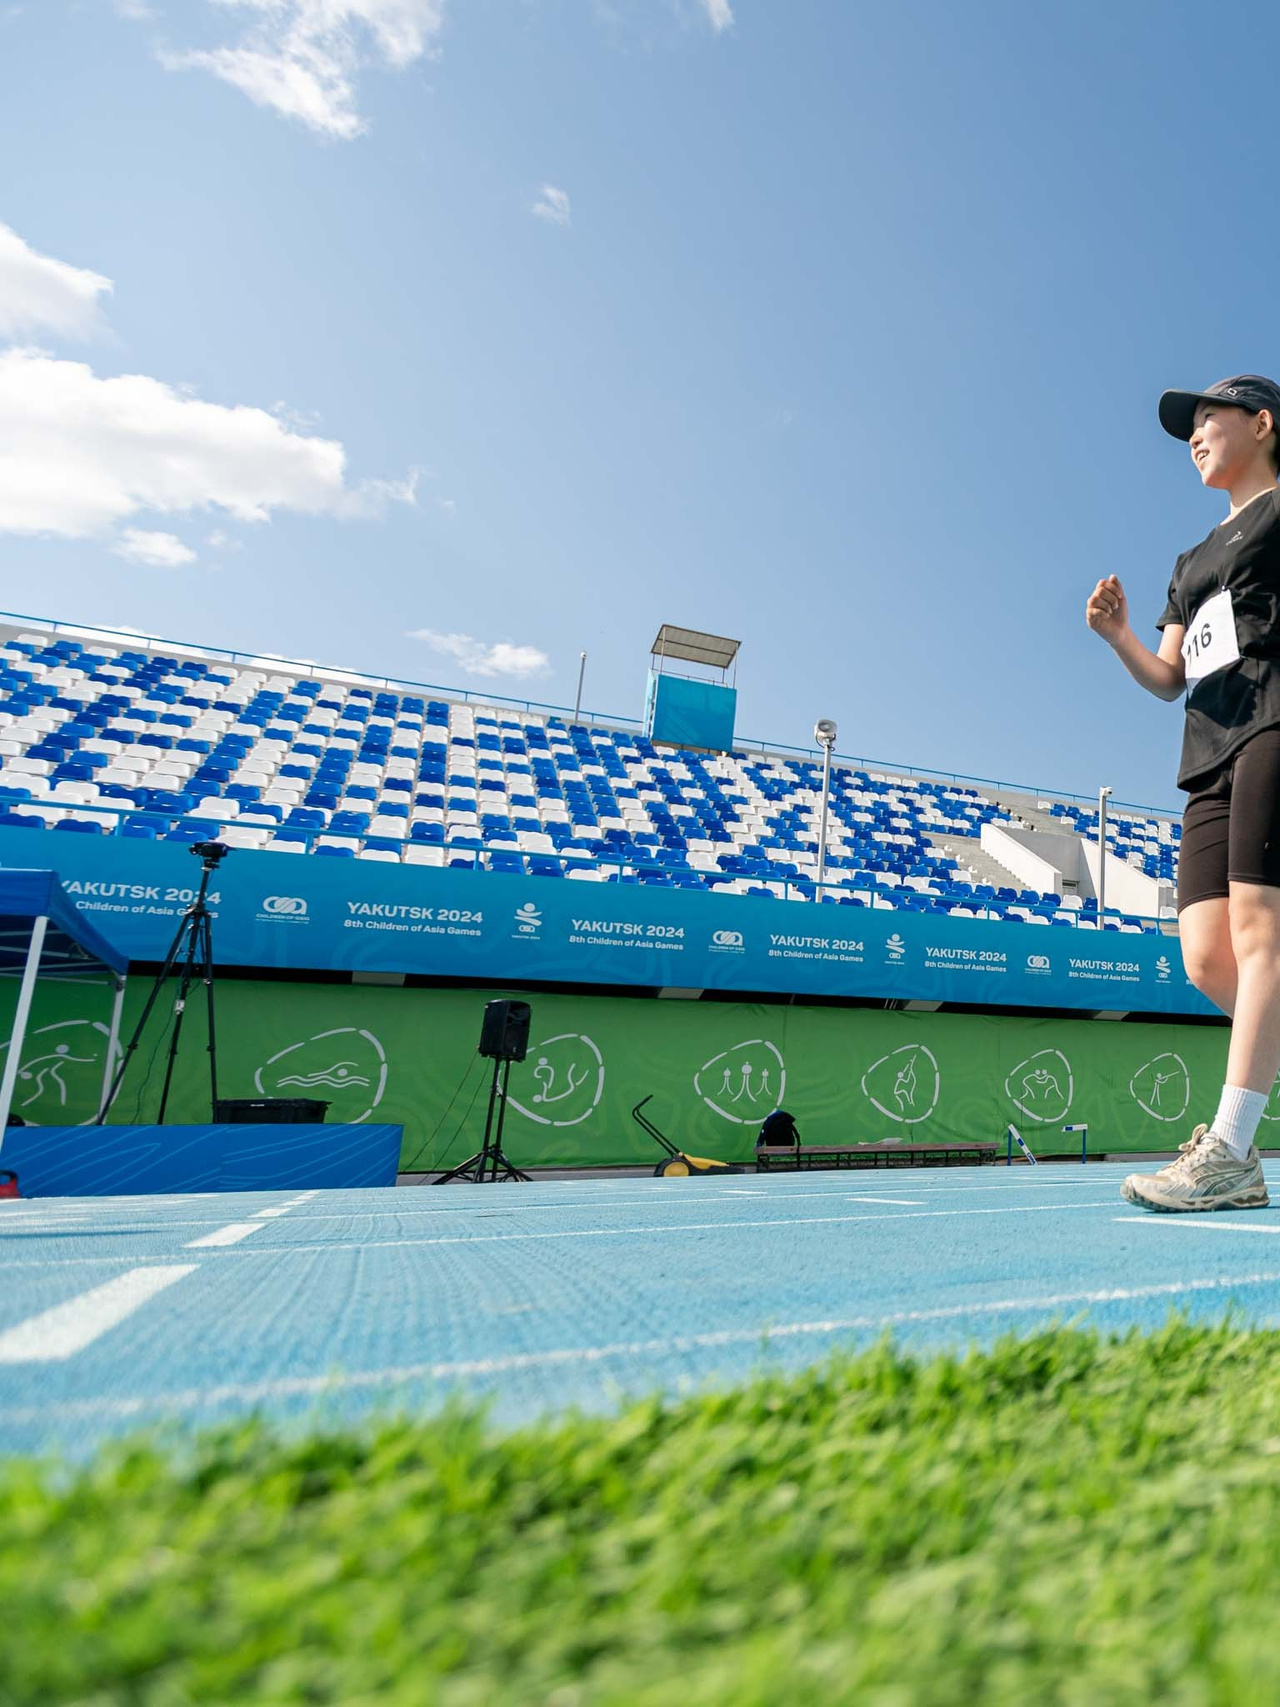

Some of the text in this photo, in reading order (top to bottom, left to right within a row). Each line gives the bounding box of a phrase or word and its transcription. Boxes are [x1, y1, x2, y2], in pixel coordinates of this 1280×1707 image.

[76, 900, 128, 914] Children
[132, 905, 144, 914] of
[147, 906, 174, 916] Asia
[347, 902, 483, 924] YAKUTSK 2024
[344, 919, 482, 936] 8th Children of Asia Games
[572, 919, 685, 938] YAKUTSK 2024
[569, 935, 586, 943] 8th
[587, 936, 623, 946] Children
[635, 940, 653, 948] Asia
[655, 942, 684, 950] Games
[770, 934, 864, 952] YAKUTSK 2024
[768, 949, 782, 957] 8th
[783, 950, 814, 959] Children
[840, 954, 864, 962] Games
[926, 946, 1007, 962] YAKUTSK 2024
[924, 960, 936, 968] 8th
[938, 962, 963, 970] Children
[986, 965, 1006, 973] Games
[1068, 958, 1140, 973] YAKUTSK 2024
